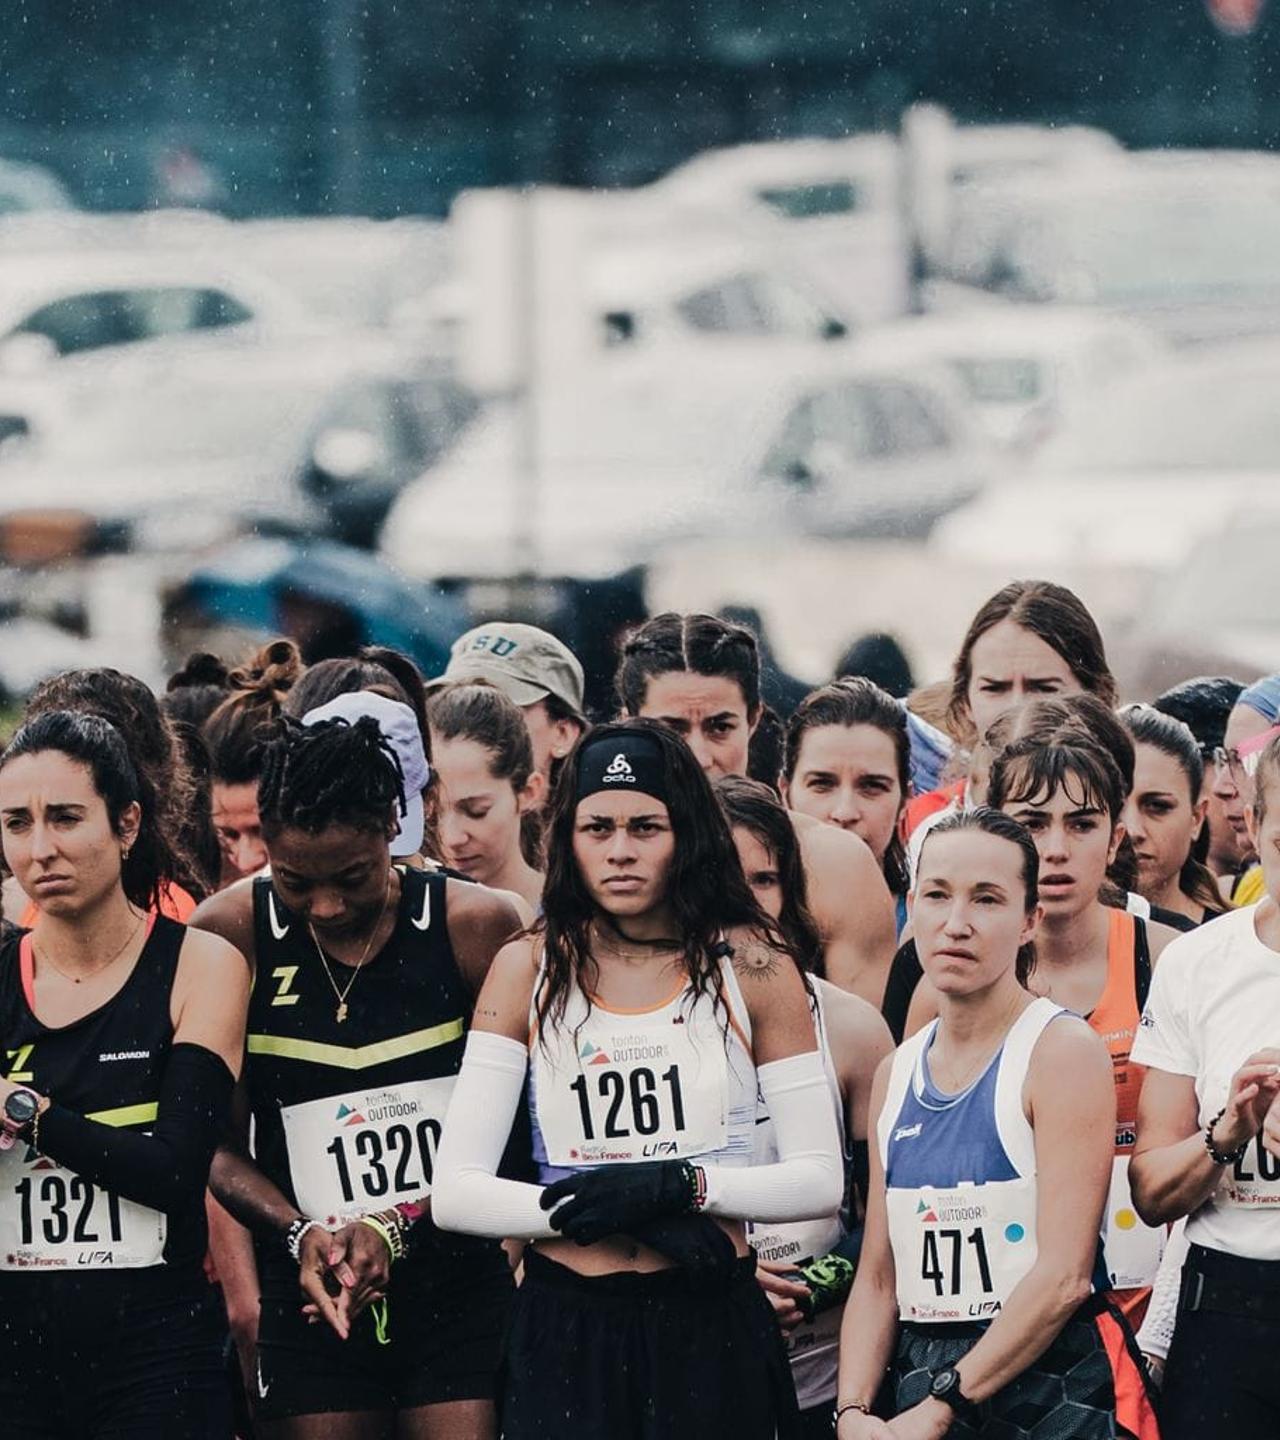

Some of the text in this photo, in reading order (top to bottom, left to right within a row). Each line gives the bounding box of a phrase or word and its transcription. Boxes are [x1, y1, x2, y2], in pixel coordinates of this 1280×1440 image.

[99, 1050, 150, 1062] SALOMON
[613, 1046, 664, 1063] OUTDOOR
[368, 1102, 419, 1122] OUTDOOR
[570, 1064, 686, 1140] 1261
[642, 1141, 678, 1157] LIFA
[326, 1118, 442, 1203] 1320
[14, 1175, 123, 1245] 1321
[77, 1250, 114, 1265] LIFA
[920, 1226, 993, 1296] 471
